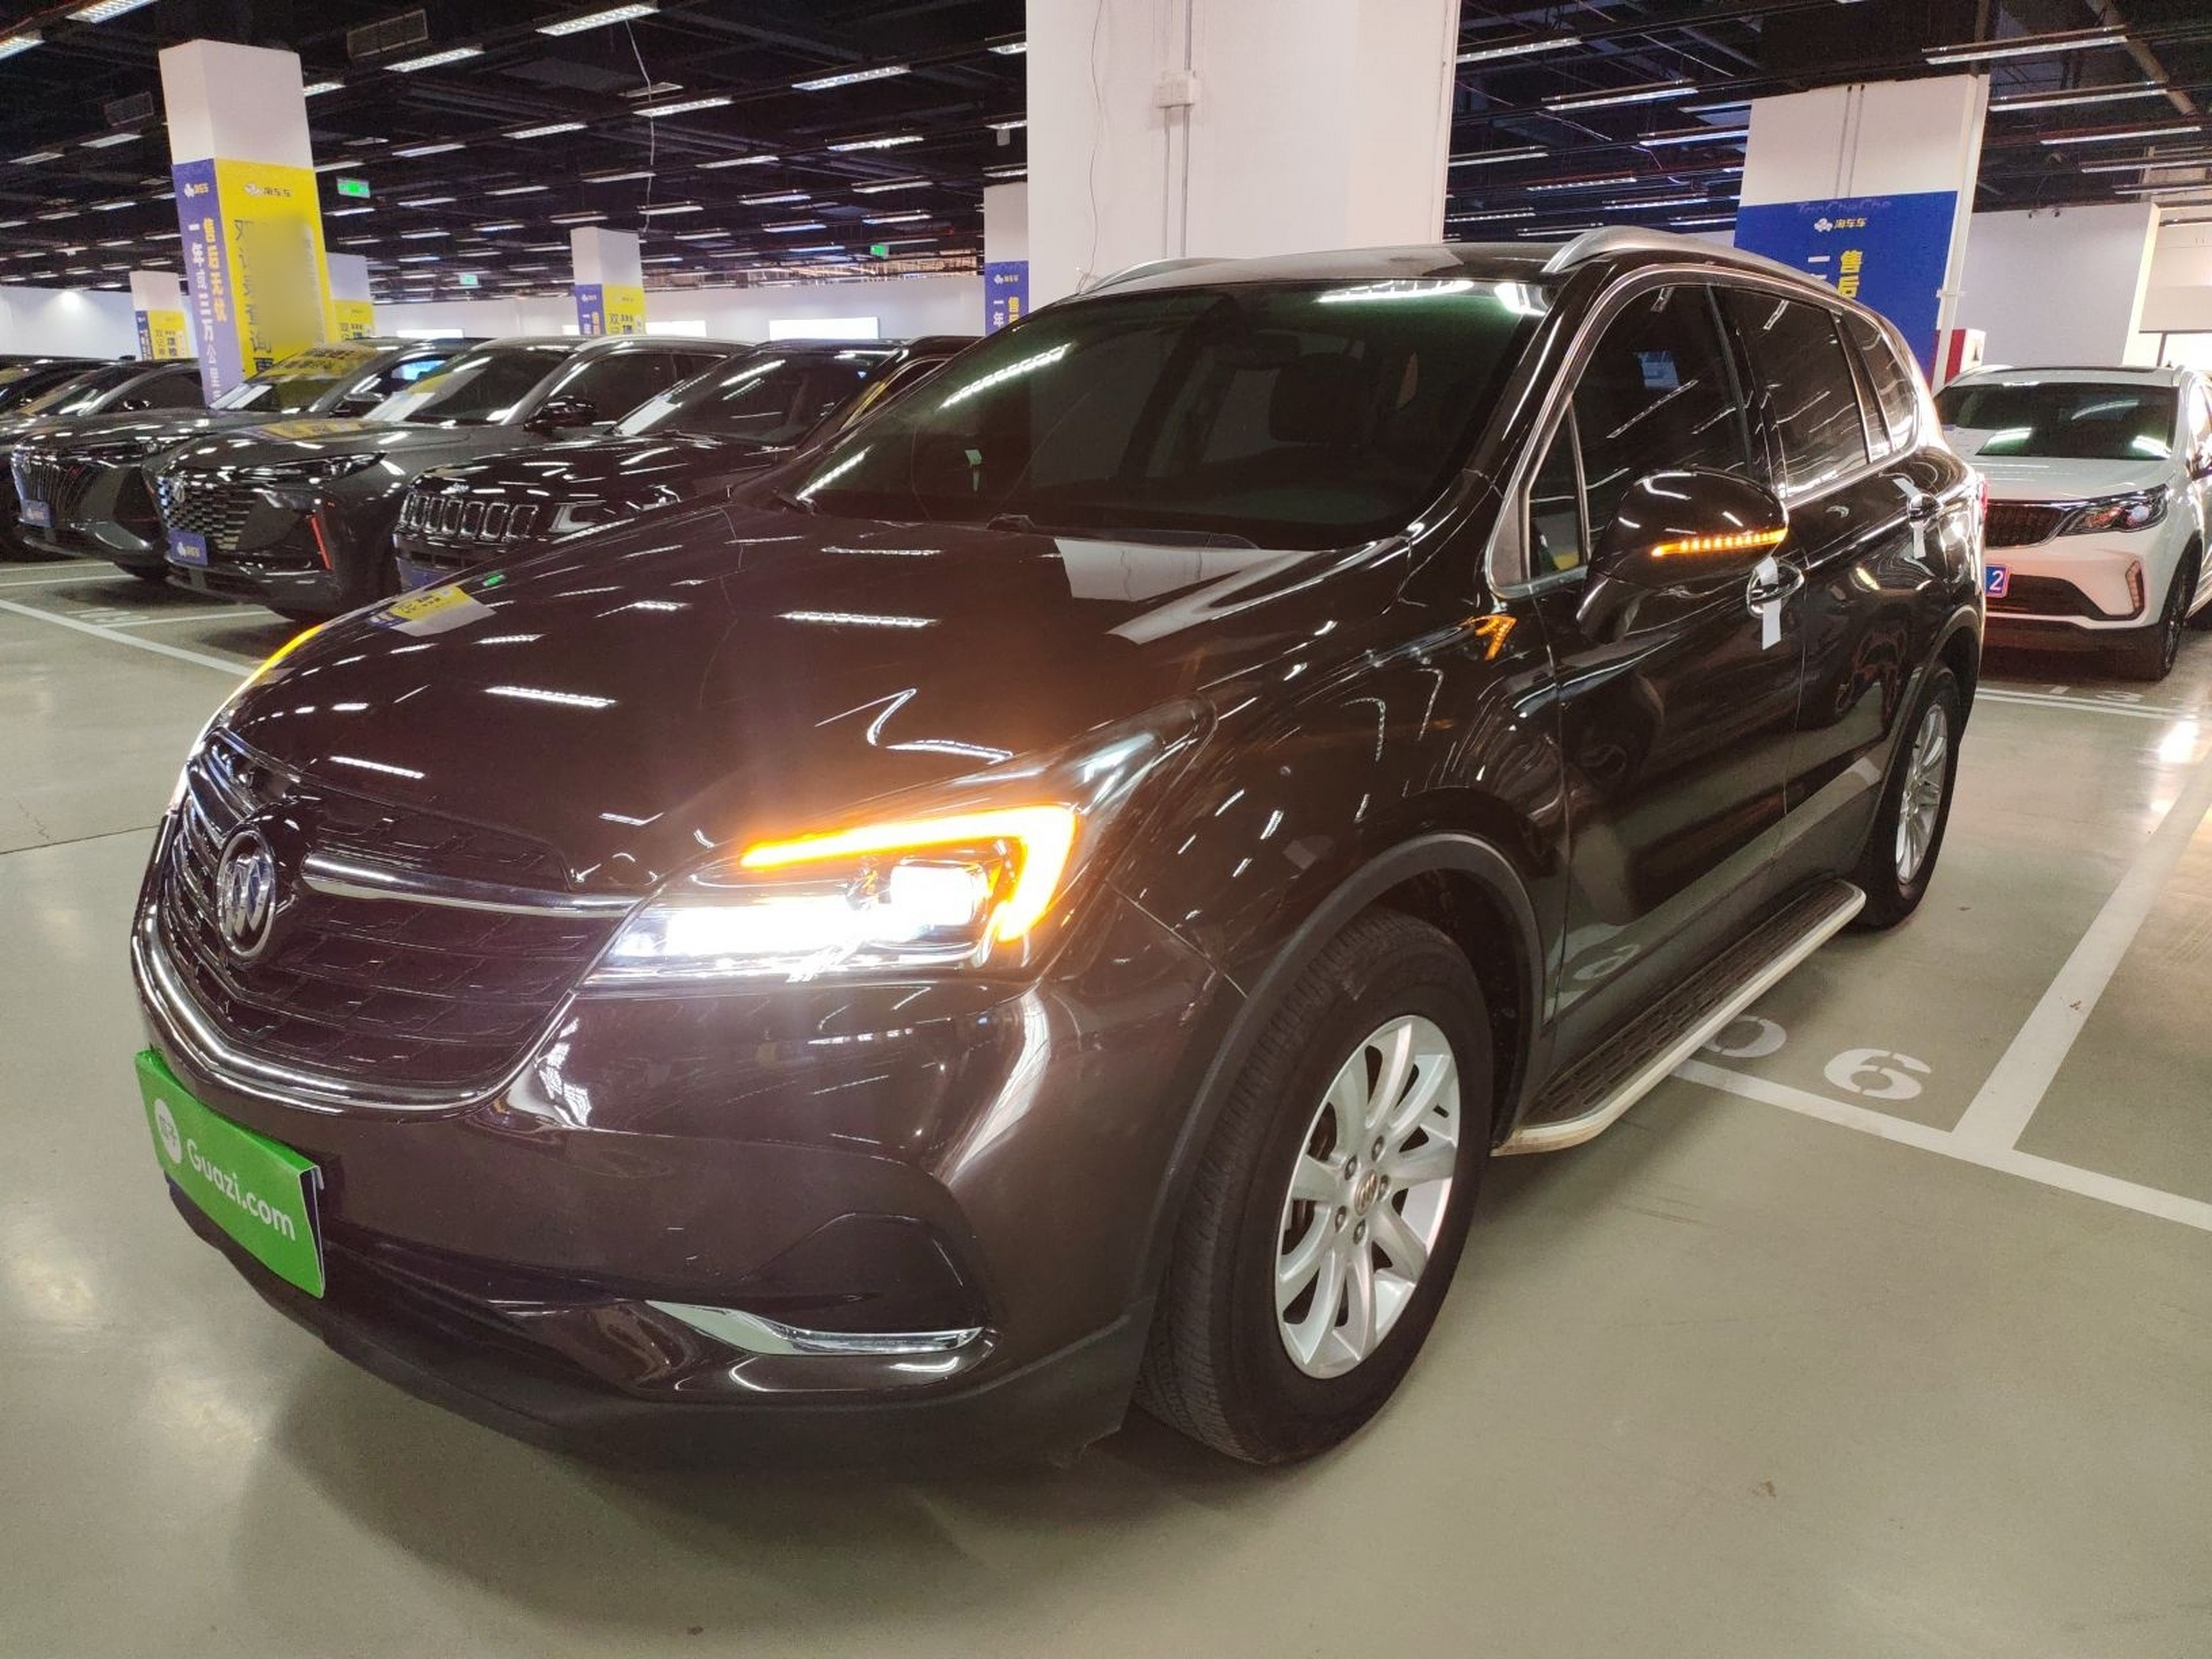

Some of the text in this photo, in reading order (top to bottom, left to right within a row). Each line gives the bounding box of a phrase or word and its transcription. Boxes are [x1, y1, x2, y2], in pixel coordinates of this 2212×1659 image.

[1836, 249, 1863, 298] 售后
[1989, 570, 2003, 590] 2
[187, 1138, 296, 1241] Guazi.com
